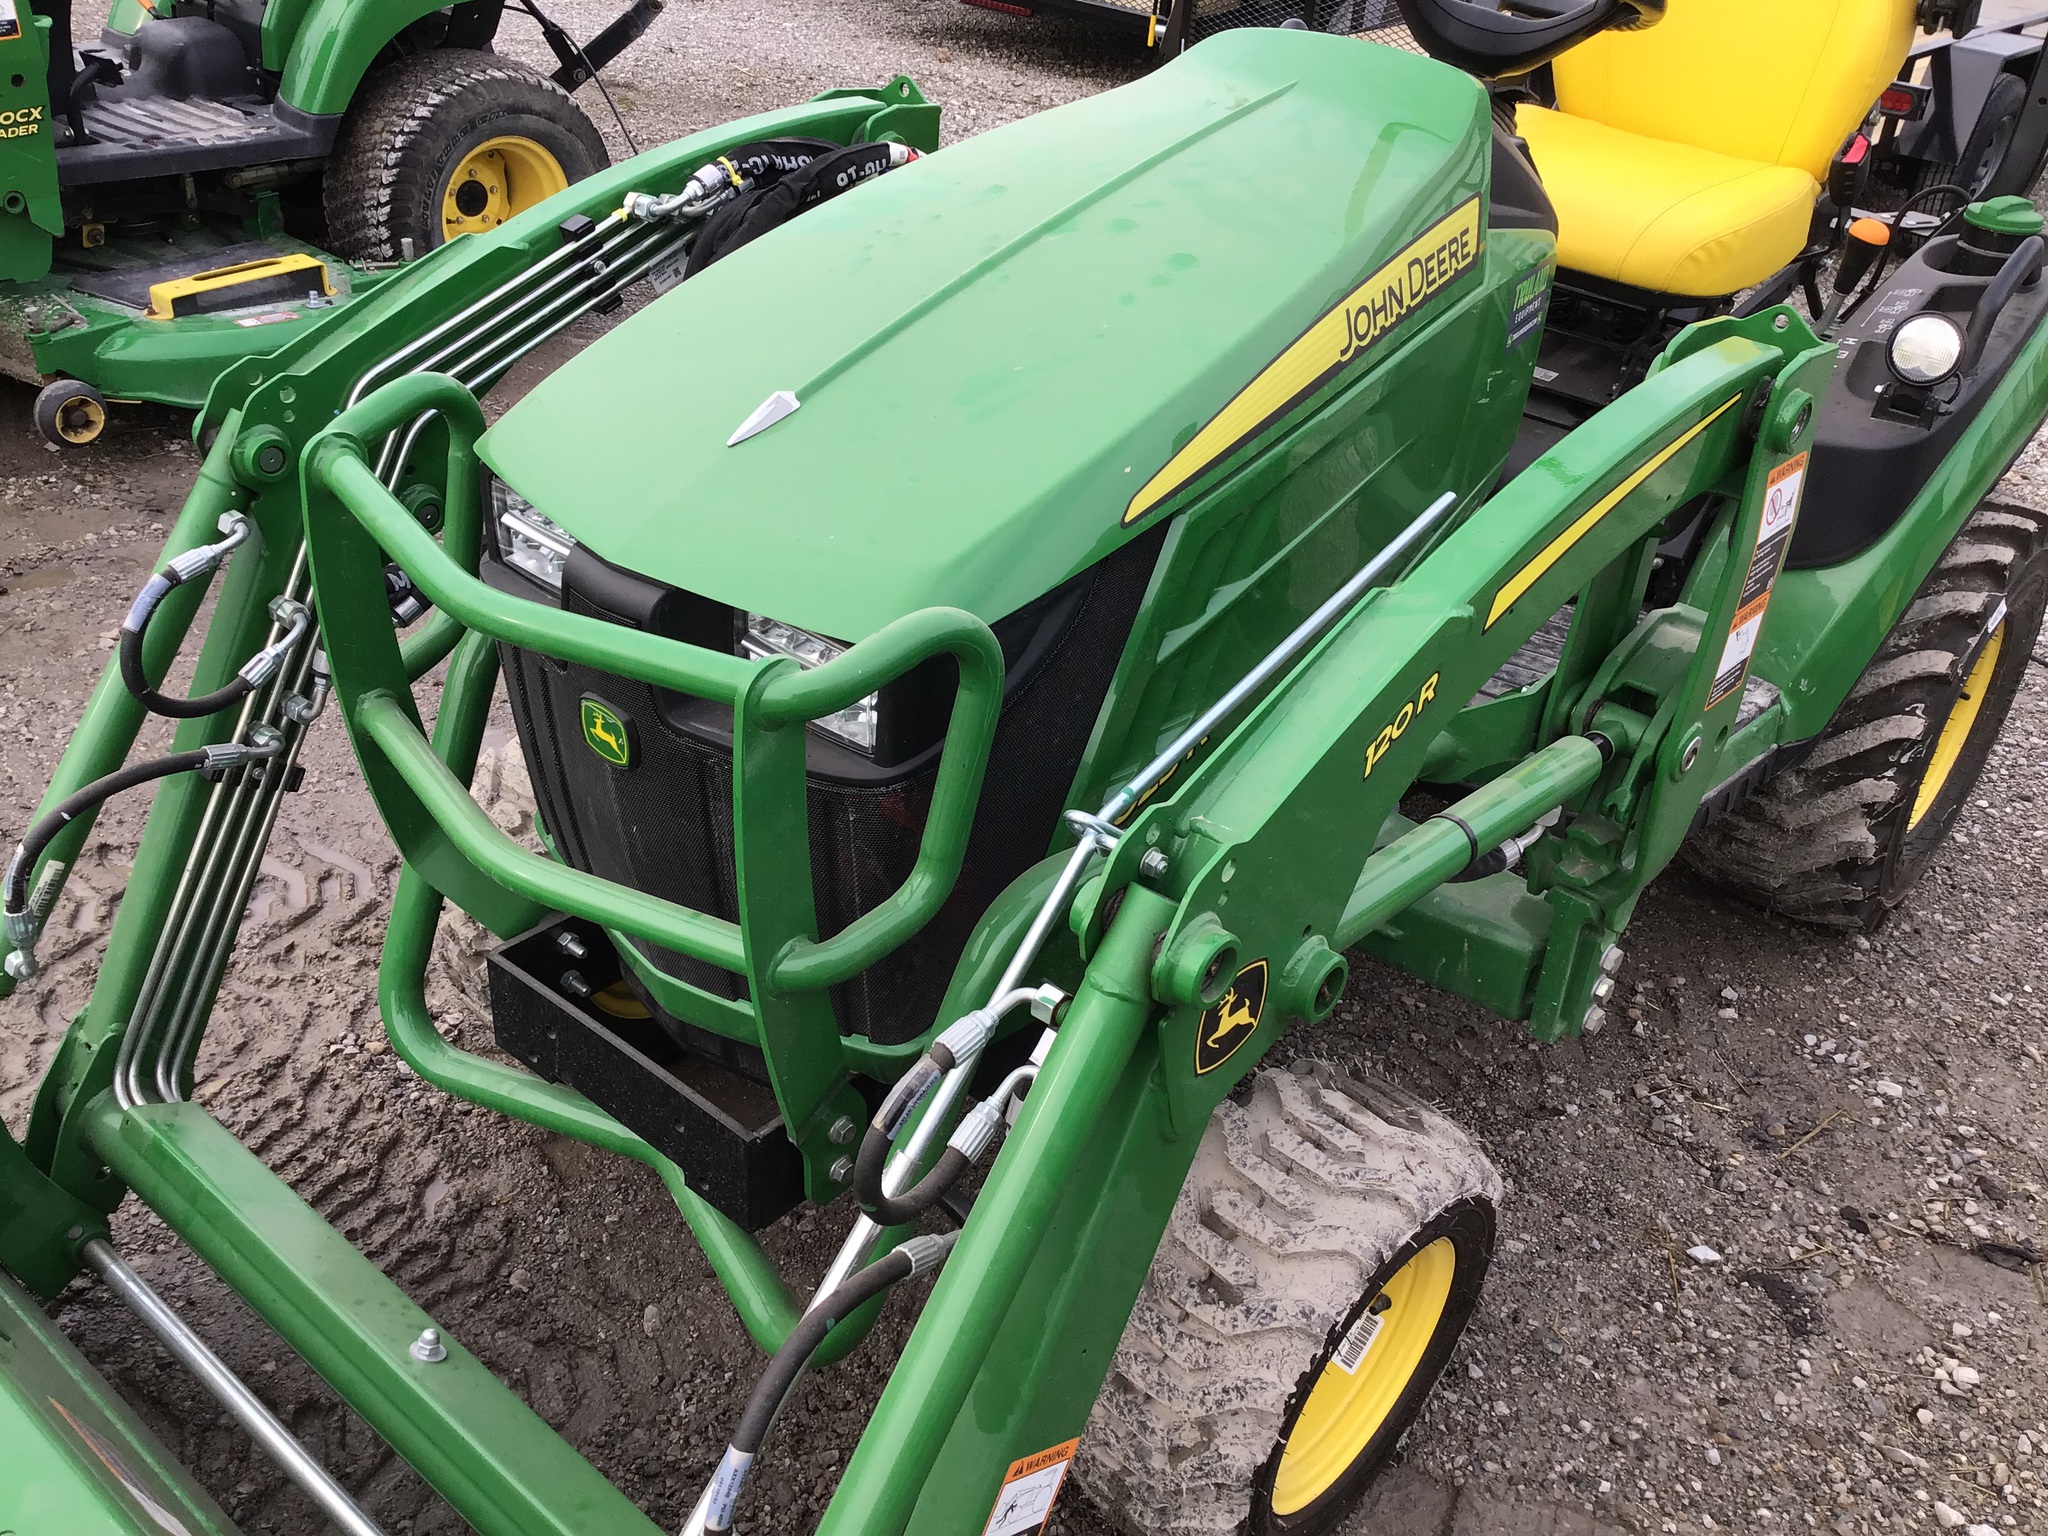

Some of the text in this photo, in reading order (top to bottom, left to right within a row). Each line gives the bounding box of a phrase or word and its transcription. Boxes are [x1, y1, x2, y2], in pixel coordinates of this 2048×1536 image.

[1339, 226, 1471, 358] JOHN DEERE
[1775, 455, 1805, 480] WARNING
[1363, 672, 1439, 779] 120 R
[1025, 1445, 1070, 1472] WARNING
